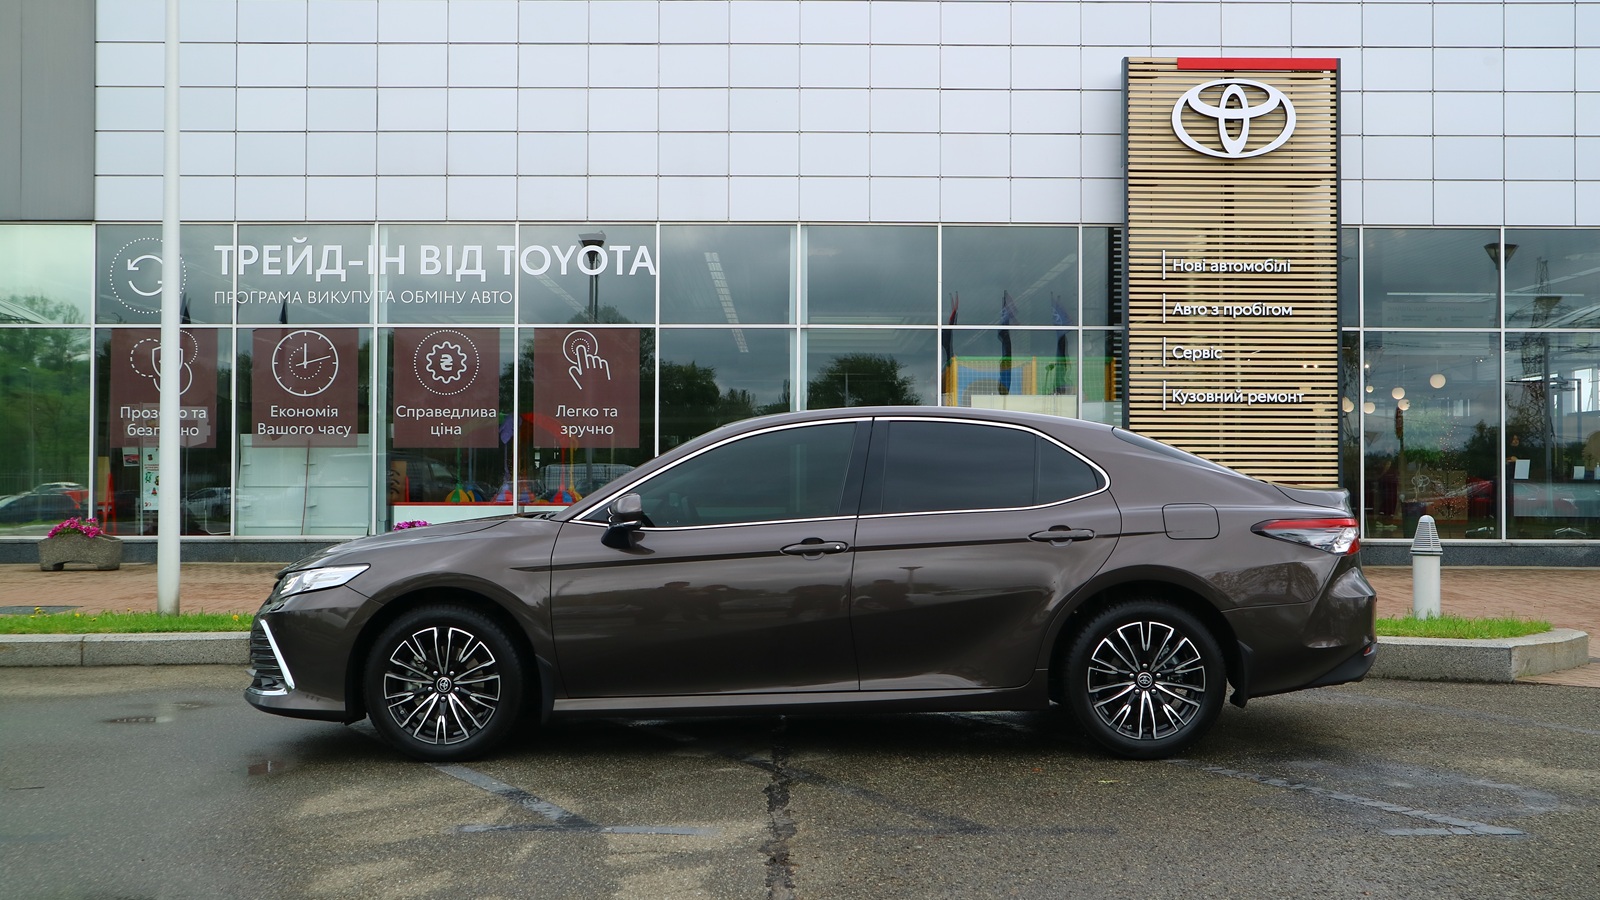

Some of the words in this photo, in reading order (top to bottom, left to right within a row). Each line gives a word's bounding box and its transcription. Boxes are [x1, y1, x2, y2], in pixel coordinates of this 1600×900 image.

[213, 236, 405, 283] ТРЕЙД-ІН
[420, 245, 487, 282] ВІД
[496, 244, 656, 276] TOYOTA
[1172, 258, 1206, 272] Нові
[1210, 258, 1291, 273] автомобілі
[214, 290, 302, 304] ПРОГРАМА
[308, 290, 373, 304] ВИКУПУ
[377, 290, 396, 304] ТА
[400, 290, 466, 304] ОБМІНУ
[470, 290, 513, 304] АВТО
[1172, 302, 1207, 316] Авто
[1211, 306, 1219, 316] з
[1223, 302, 1293, 319] пробігом
[1172, 346, 1223, 362] Сервіс
[1172, 388, 1245, 406] Кузовний
[1248, 392, 1305, 406] ремонт
[120, 406, 187, 421] Прозо
[191, 409, 206, 419] та
[270, 405, 338, 417] Економія
[395, 405, 497, 420] Справедлива
[555, 405, 599, 418] Легко
[603, 408, 618, 418] та
[257, 423, 314, 435] Вашого
[318, 425, 352, 438] часу
[430, 423, 462, 436] ціна
[560, 425, 614, 438] зручно
